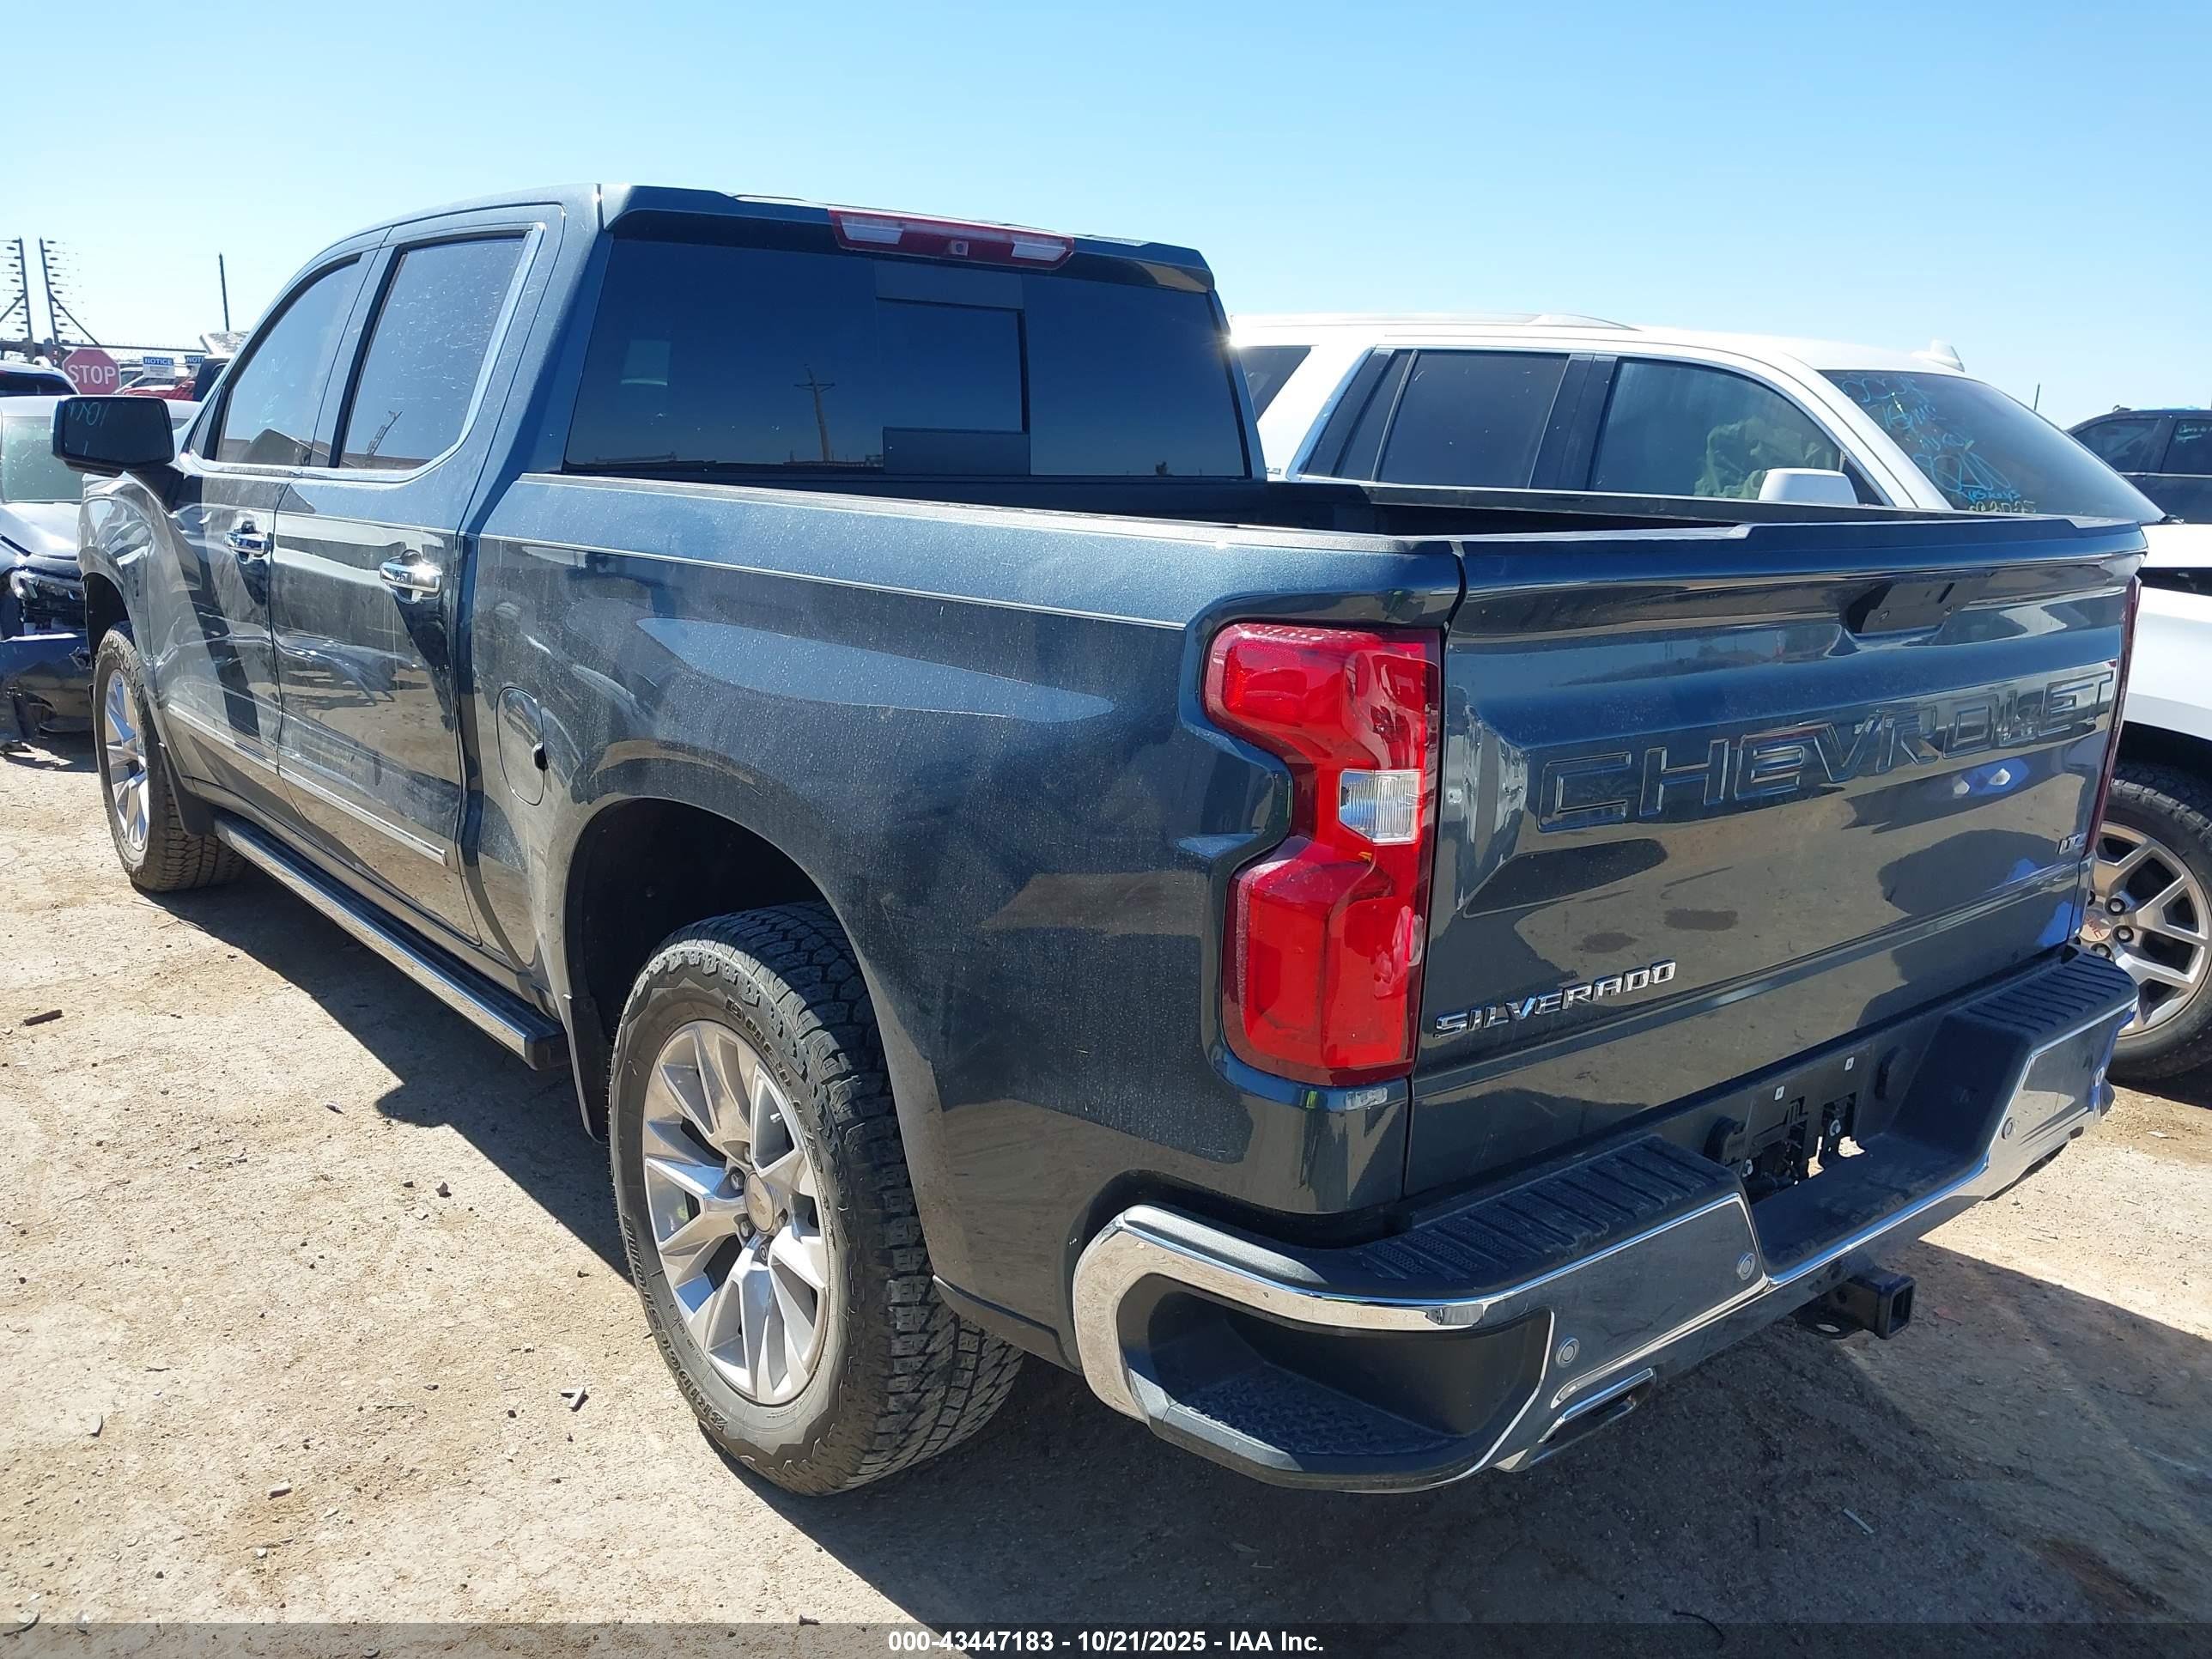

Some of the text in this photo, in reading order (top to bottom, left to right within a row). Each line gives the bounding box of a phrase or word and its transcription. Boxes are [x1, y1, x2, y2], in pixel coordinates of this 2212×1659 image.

[67, 364, 116, 385] STOP
[1536, 670, 2116, 833] CHEVROLET
[1433, 958, 1676, 1039] SILVERADO
